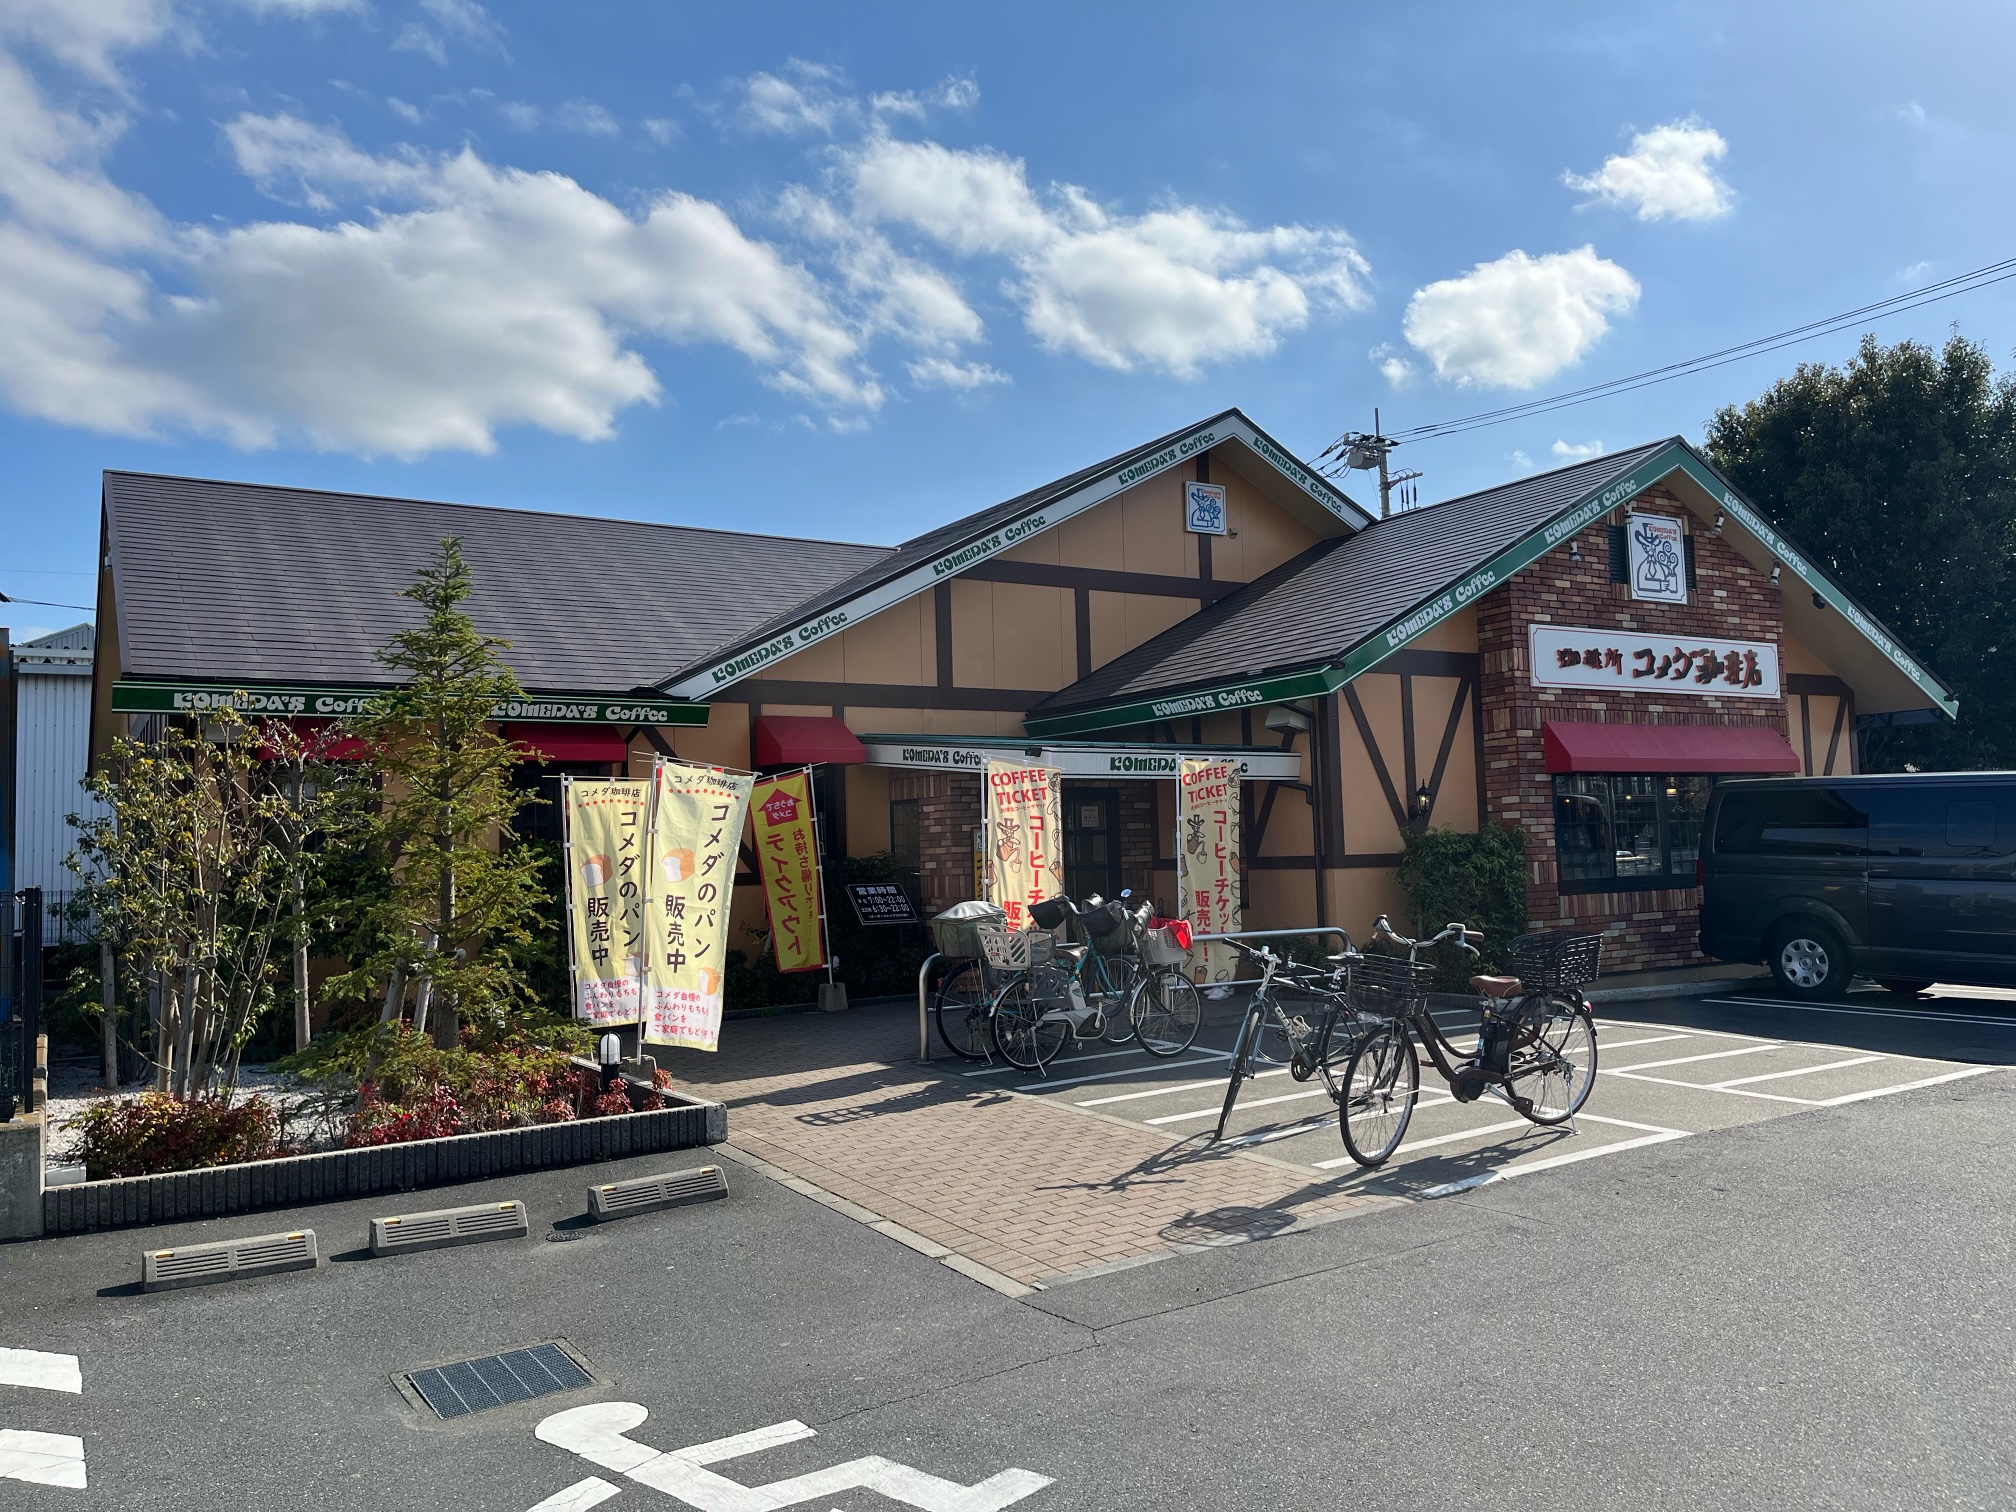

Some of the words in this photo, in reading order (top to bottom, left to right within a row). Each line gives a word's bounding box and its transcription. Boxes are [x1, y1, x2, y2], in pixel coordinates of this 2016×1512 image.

[1118, 449, 1177, 485] KOMEDA'S
[1179, 433, 1215, 455] Coffee
[1253, 436, 1308, 485] KOMEDA'S
[1309, 482, 1342, 513] Coffee
[1543, 499, 1601, 545] KOMEDA'S
[1602, 479, 1637, 507] Coffee
[932, 535, 1002, 576] KOMEDA'S
[1004, 516, 1047, 541] Coffee
[1723, 492, 1775, 545] KOMEDA'S
[1776, 541, 1808, 576] Coffee
[1385, 594, 1454, 647] KOMEDA'S
[1455, 570, 1496, 602] Coffee
[711, 635, 795, 683] KOMEDA'S
[798, 612, 848, 641] Coffee
[1846, 605, 1892, 653] KOMEDA'S
[1893, 650, 1921, 681] Coffee
[605, 706, 668, 722] Coffee
[1151, 695, 1216, 717] KOMEDA'S
[1218, 689, 1263, 706] Coffee
[902, 748, 949, 764] KOMEDA'S
[674, 774, 739, 791] コメダ珈琲店
[991, 769, 1047, 787] COFFEE
[1182, 766, 1228, 786] COFFEE
[581, 787, 641, 798] コメダ珈琲店
[996, 787, 1048, 805] TICKET
[1188, 783, 1228, 804] TICKET
[618, 811, 641, 948] コメダのパン
[694, 805, 730, 958] コメダのパン
[587, 896, 610, 967] 販売中
[665, 894, 686, 974] 販売中
[585, 979, 629, 990] コメダ自慢の
[656, 991, 701, 1002] コメダ自慢の
[584, 1000, 615, 1011] 食パンを
[654, 1012, 687, 1023] 食パンを
